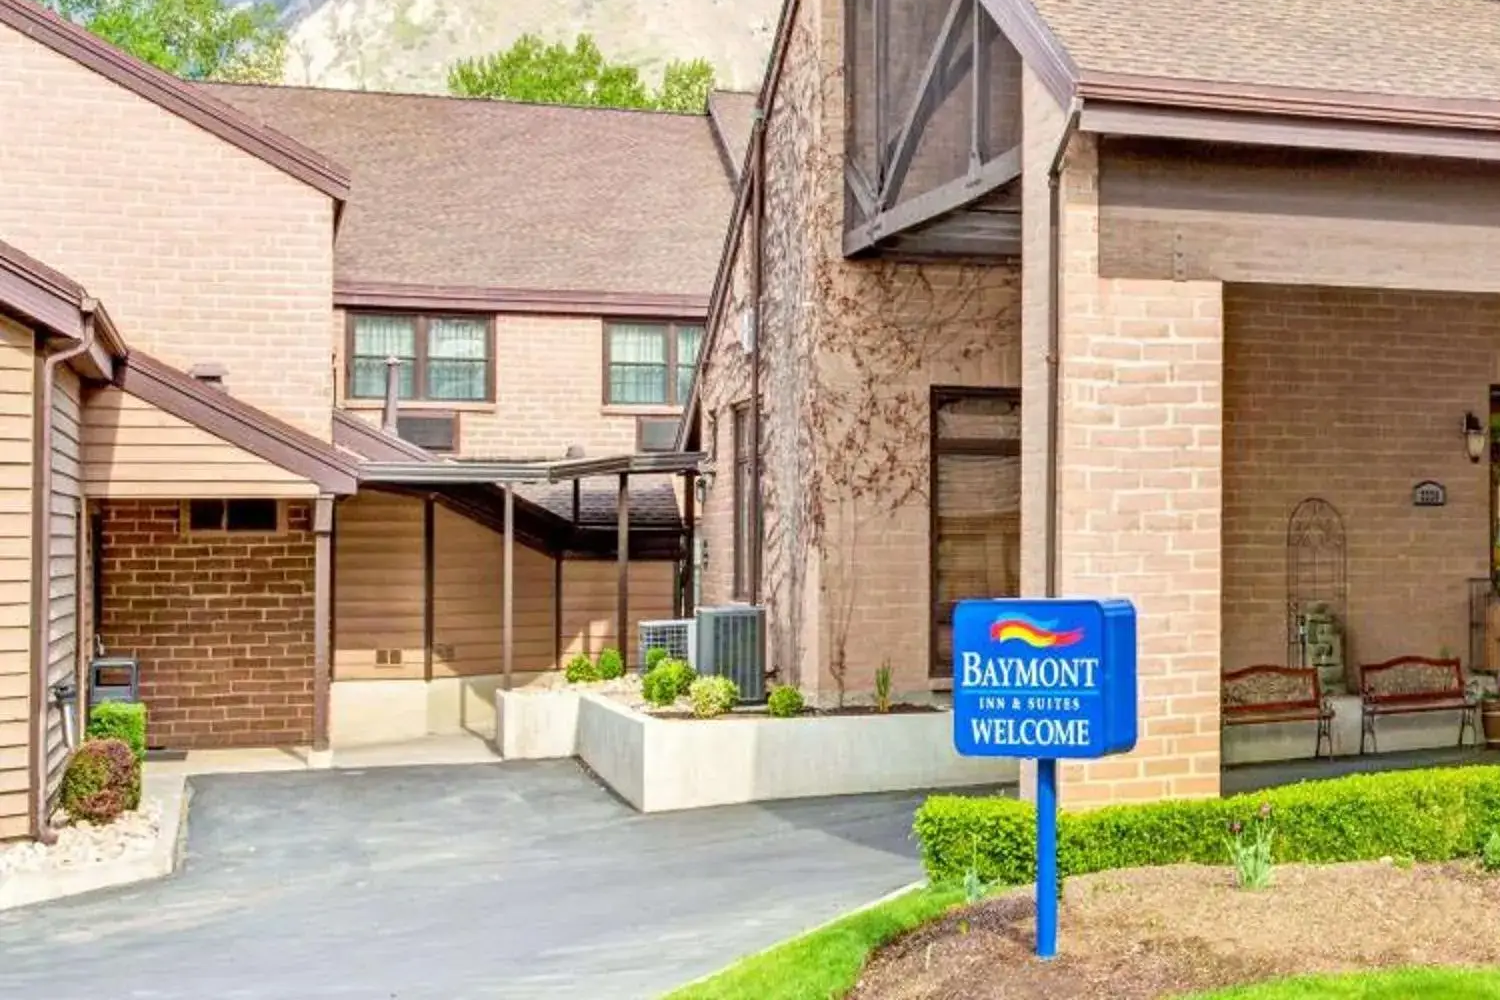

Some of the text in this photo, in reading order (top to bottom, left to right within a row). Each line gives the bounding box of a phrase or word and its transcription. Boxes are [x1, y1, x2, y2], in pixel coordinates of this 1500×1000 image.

[962, 652, 1099, 687] BAYMONT
[979, 697, 1081, 711] INN & SUITES
[971, 718, 1090, 745] WELCOME
